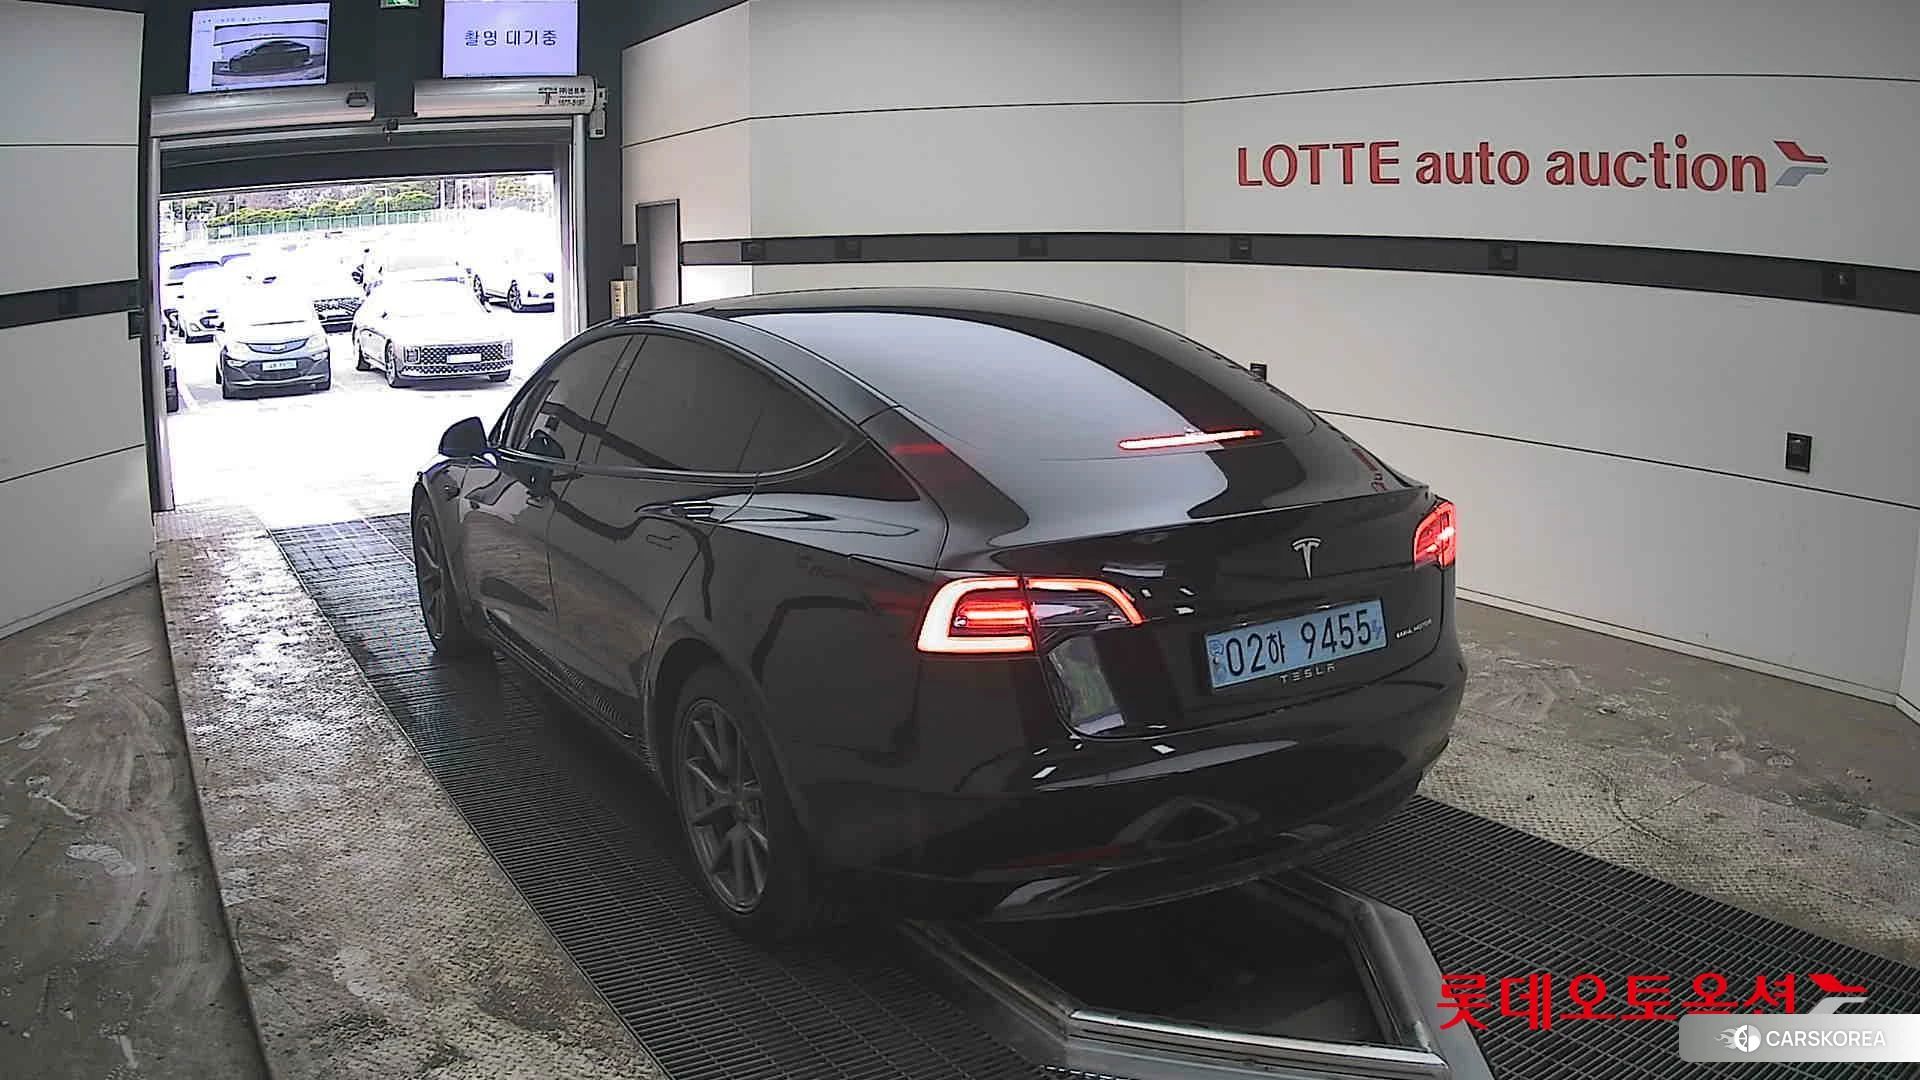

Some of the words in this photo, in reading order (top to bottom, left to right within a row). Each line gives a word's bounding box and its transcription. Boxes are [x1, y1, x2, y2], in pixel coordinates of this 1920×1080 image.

[464, 29, 497, 47] 촬영
[506, 29, 558, 47] 대기중
[1236, 141, 1398, 188] LOTTE
[1416, 142, 1531, 185] auto
[1545, 134, 1768, 194] auction
[1225, 630, 1286, 677] 02하
[1300, 608, 1372, 660] 9455
[1279, 663, 1336, 686] TESLA
